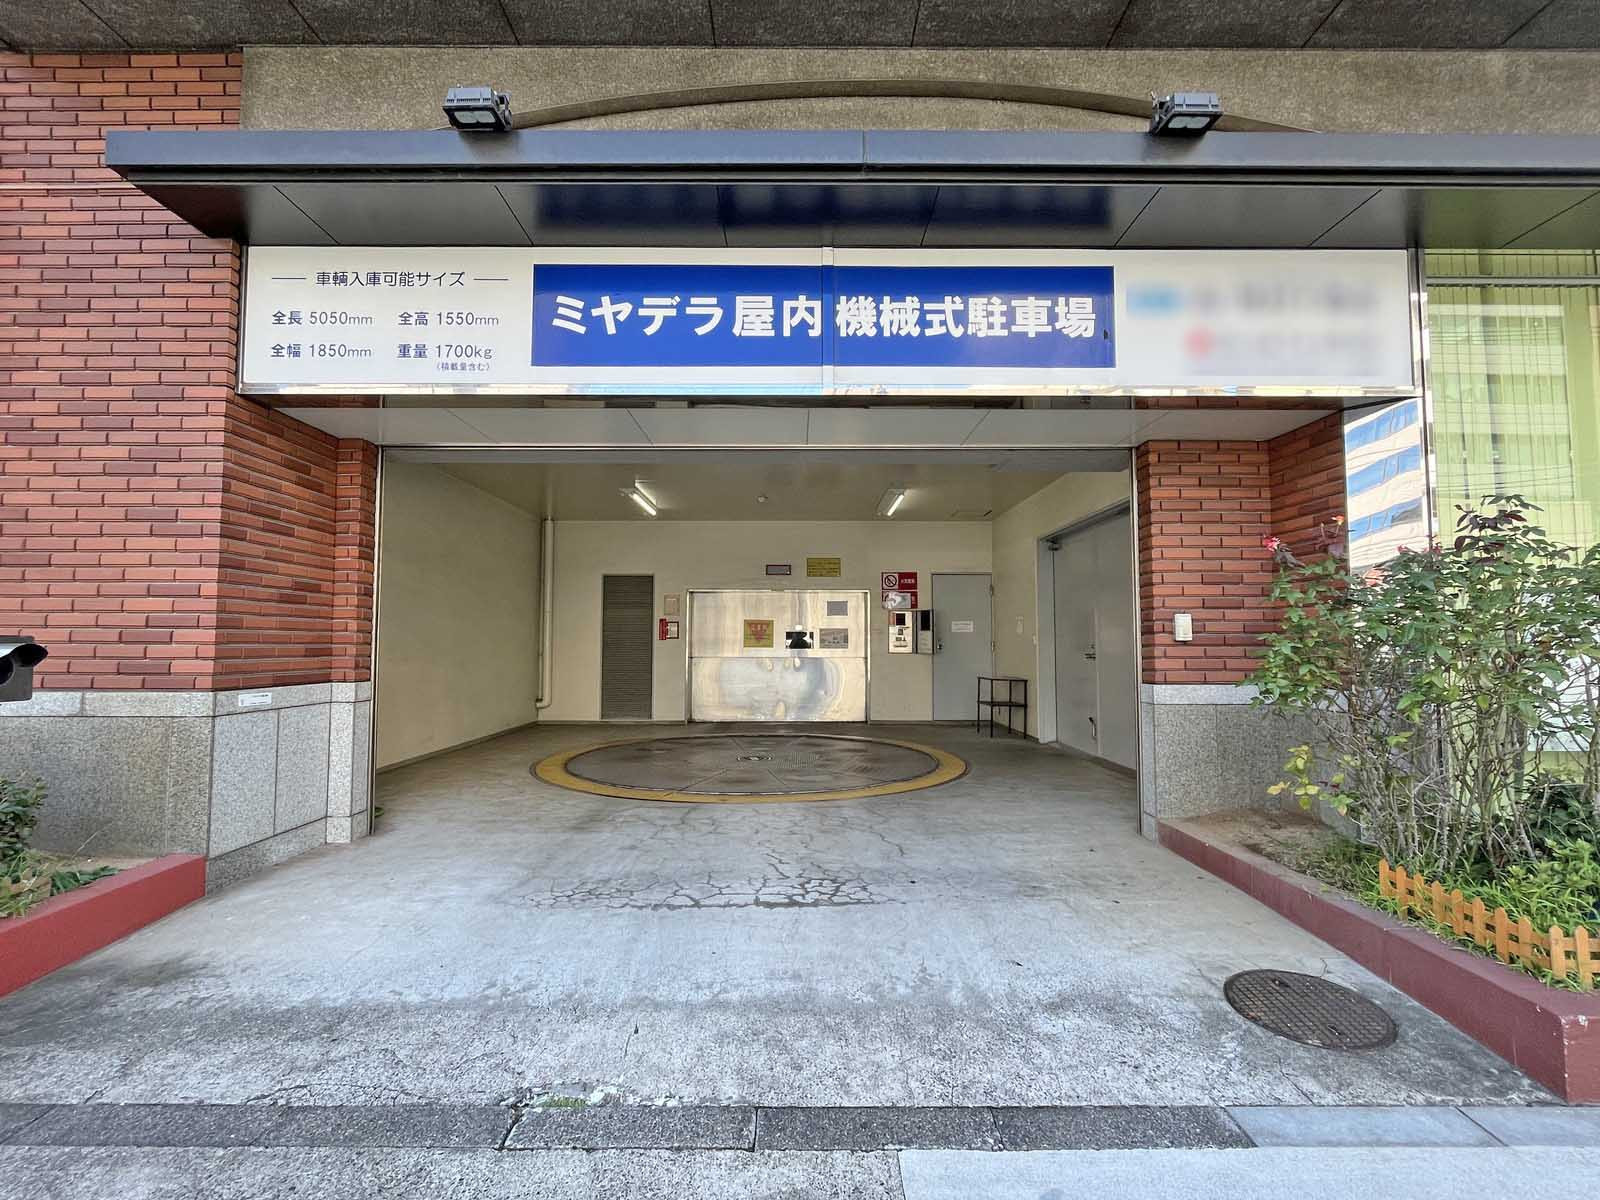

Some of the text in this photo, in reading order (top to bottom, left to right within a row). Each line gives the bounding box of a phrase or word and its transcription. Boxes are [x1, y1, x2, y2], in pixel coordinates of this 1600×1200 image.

[271, 310, 373, 327] 全長 5050mm
[398, 311, 500, 327] 全高 1550mm
[270, 343, 372, 359] 全幅 1850mm
[396, 343, 493, 360] 重量 1700kg
